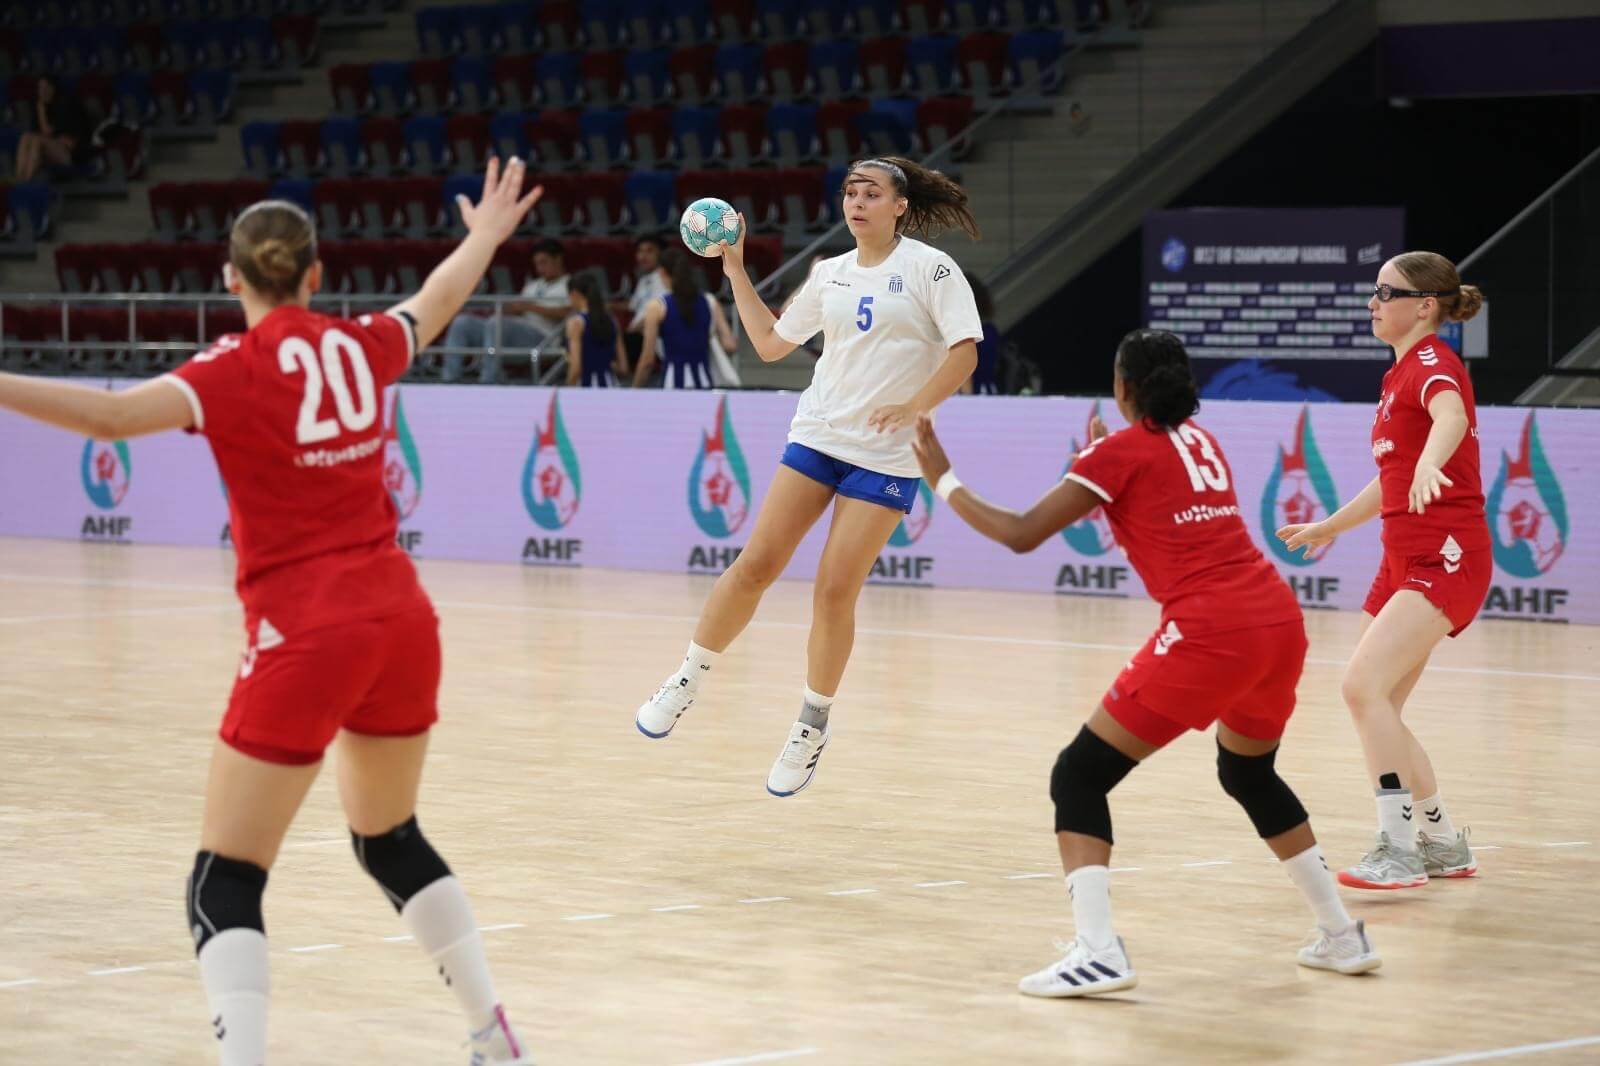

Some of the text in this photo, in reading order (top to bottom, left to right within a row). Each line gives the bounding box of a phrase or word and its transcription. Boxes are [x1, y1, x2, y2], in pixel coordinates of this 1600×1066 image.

[856, 296, 874, 332] 5
[278, 328, 377, 444] 20
[1169, 423, 1229, 492] 13
[82, 516, 132, 537] AHF
[522, 537, 582, 561] AHF
[869, 556, 934, 579] AHF
[1055, 564, 1129, 590] AHF
[1290, 575, 1340, 601] HF
[1485, 585, 1569, 614] AHF
